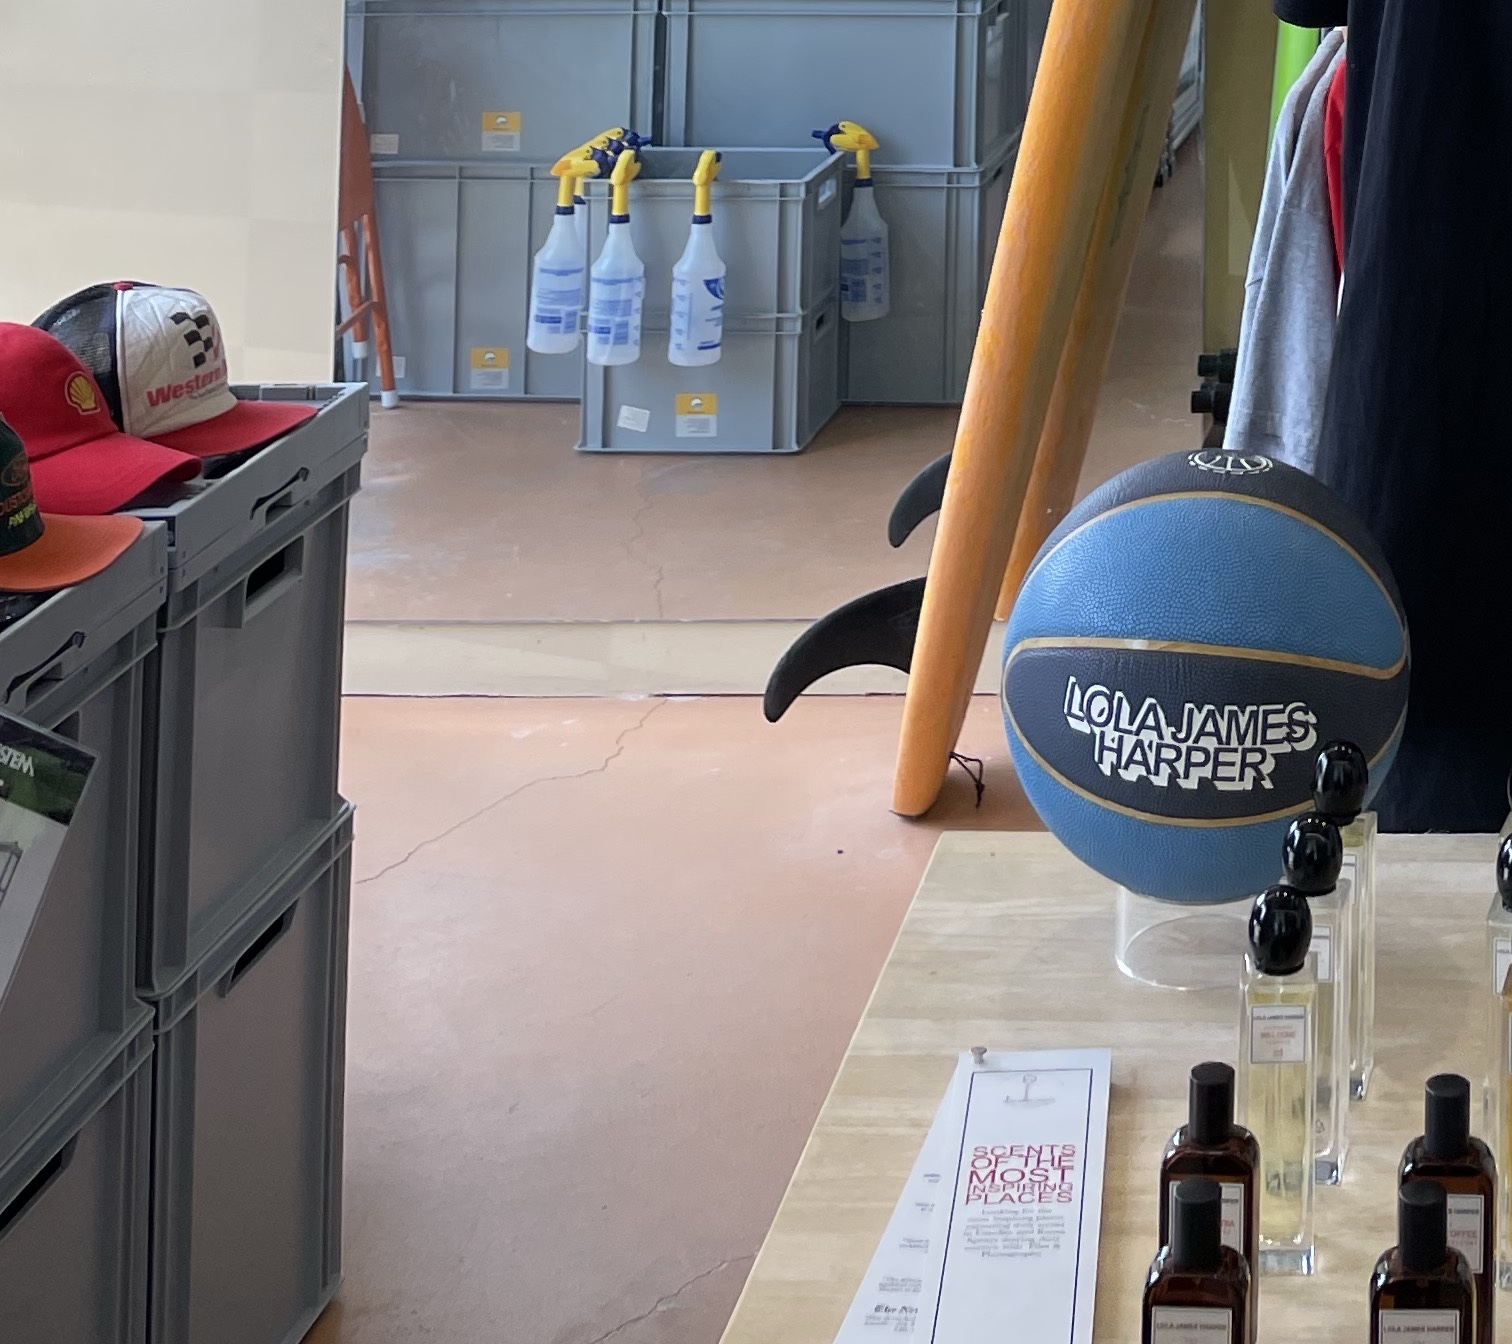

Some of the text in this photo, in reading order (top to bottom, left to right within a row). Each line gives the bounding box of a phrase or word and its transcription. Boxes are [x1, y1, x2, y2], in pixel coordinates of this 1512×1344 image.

[1064, 676, 1318, 754] LOLA JAMES
[1094, 730, 1275, 790] HARPER
[973, 1144, 1076, 1158] SCENTS
[971, 1154, 1075, 1171] OF THE
[969, 1168, 1075, 1184] MOST
[965, 1192, 1073, 1205] PLACES
